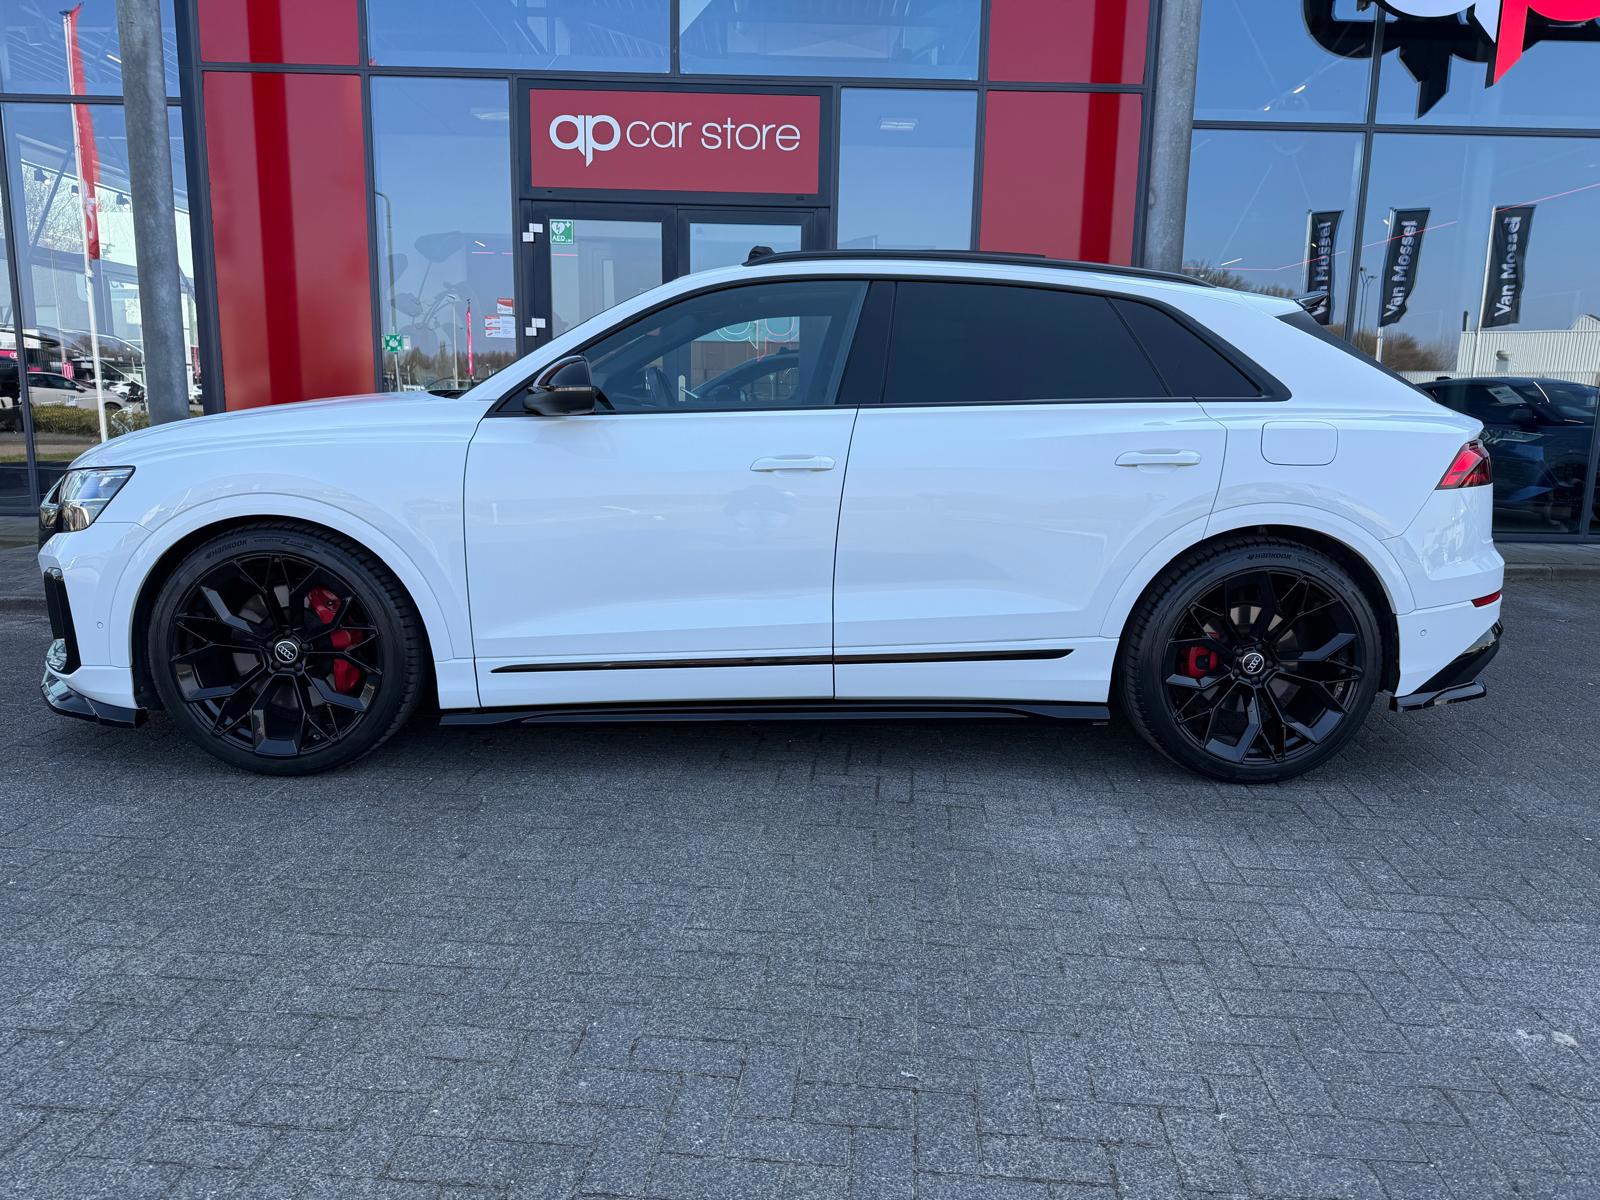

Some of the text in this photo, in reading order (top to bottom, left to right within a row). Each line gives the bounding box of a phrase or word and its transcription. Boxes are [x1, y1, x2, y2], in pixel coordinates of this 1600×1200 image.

[549, 114, 801, 167] ap car store
[1314, 221, 1332, 281] Mossel
[1383, 220, 1418, 317] Van Mossel
[1494, 216, 1522, 317] Van Mossel
